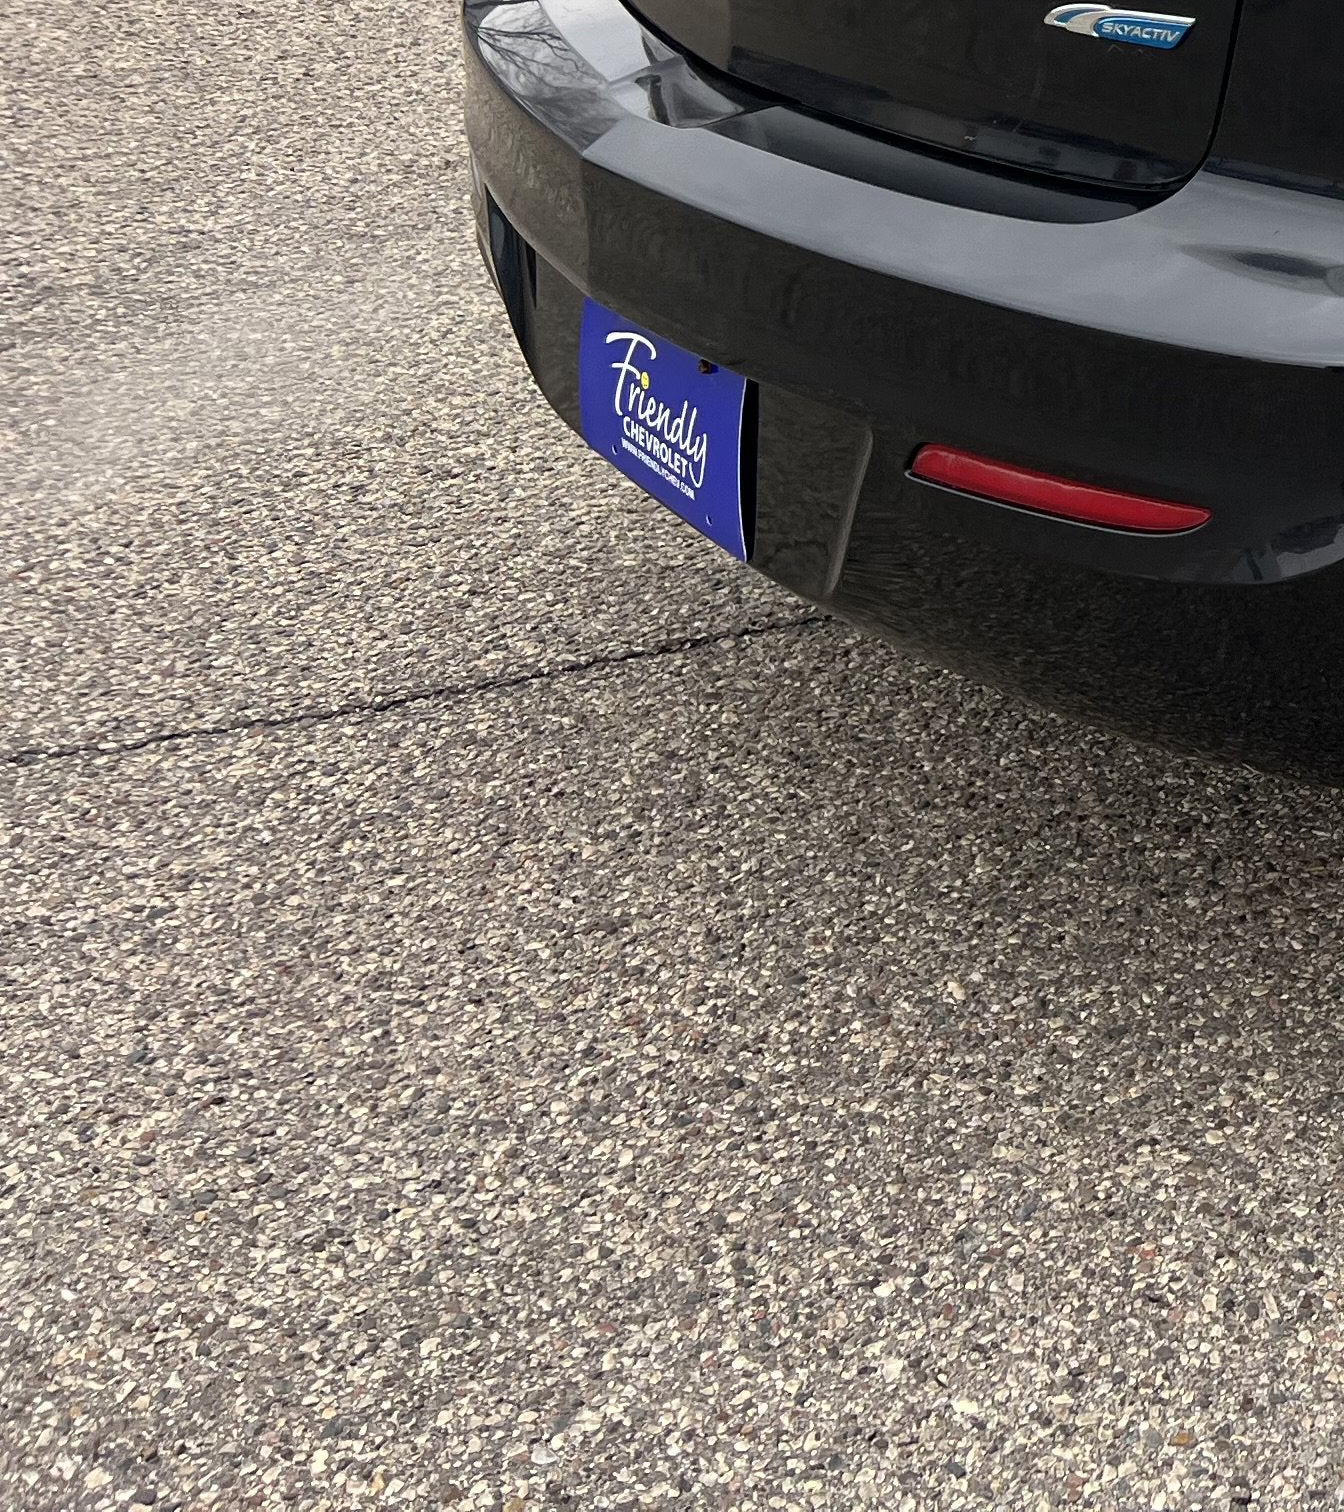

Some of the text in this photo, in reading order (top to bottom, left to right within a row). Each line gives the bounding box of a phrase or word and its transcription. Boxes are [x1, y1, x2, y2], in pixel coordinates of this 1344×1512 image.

[1101, 22, 1181, 42] SKYACTIV
[605, 331, 708, 489] Friendly
[623, 415, 689, 479] CHEVROLET
